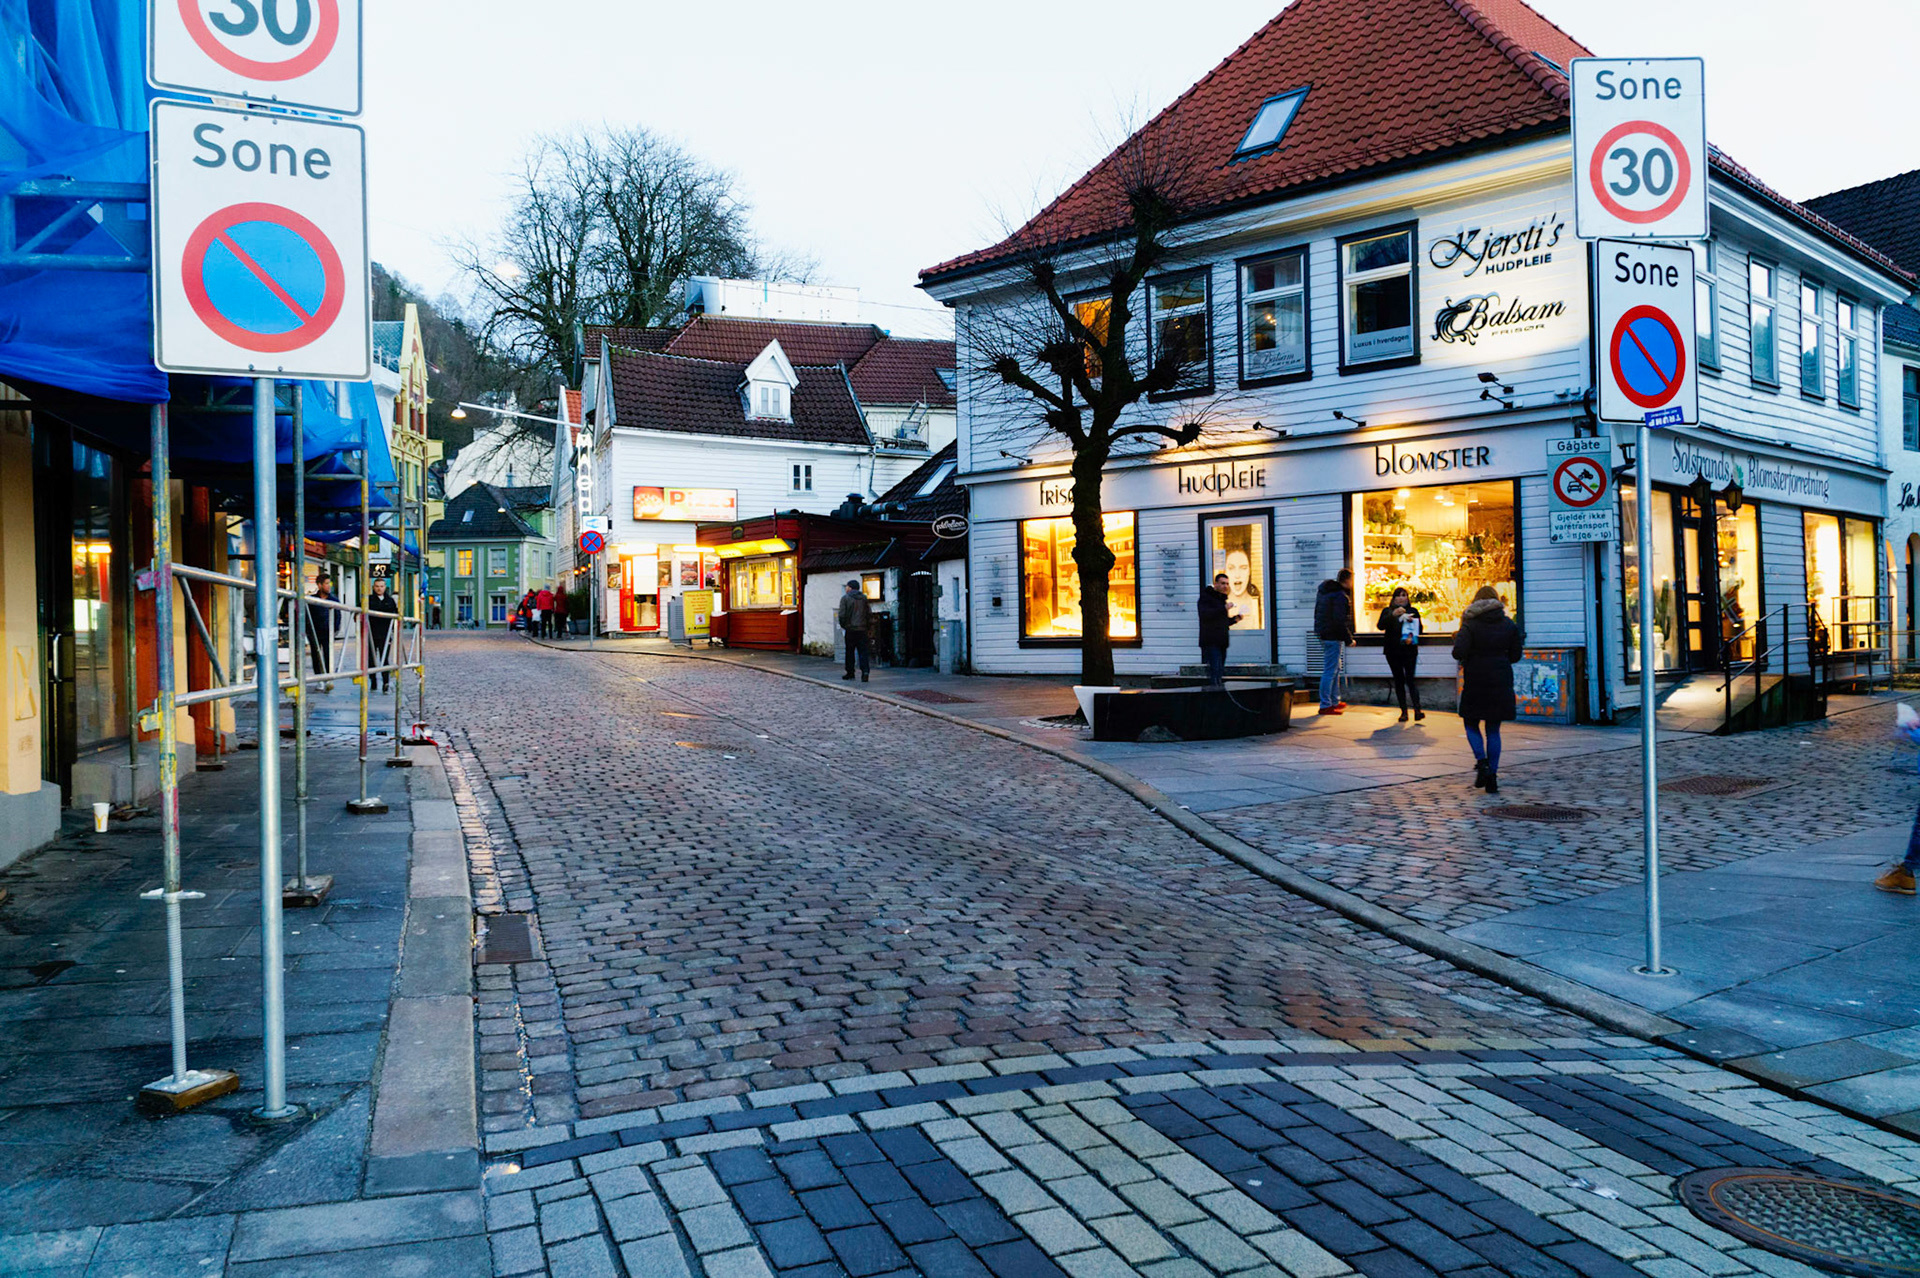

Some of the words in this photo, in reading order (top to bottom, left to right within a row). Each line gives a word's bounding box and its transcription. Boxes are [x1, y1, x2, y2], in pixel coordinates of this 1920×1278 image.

[209, 0, 312, 46] 30
[1595, 70, 1682, 100] Sone
[192, 122, 332, 180] Sone
[1609, 147, 1674, 197] 30
[1429, 212, 1565, 278] Kjersti's
[1485, 253, 1552, 275] HUDPLEIE
[1614, 251, 1679, 288] Sone
[1450, 294, 1567, 334] Balsam
[1353, 341, 1373, 349] Luxus
[1377, 334, 1410, 345] hverdagen
[1648, 413, 1682, 427] TRUMP
[1557, 440, 1600, 453] Gågate
[1672, 436, 1731, 482] Solstrands
[1746, 454, 1830, 504] Blomsterforretning
[1554, 522, 1610, 531] varetransport
[1556, 513, 1586, 522] Gjelder
